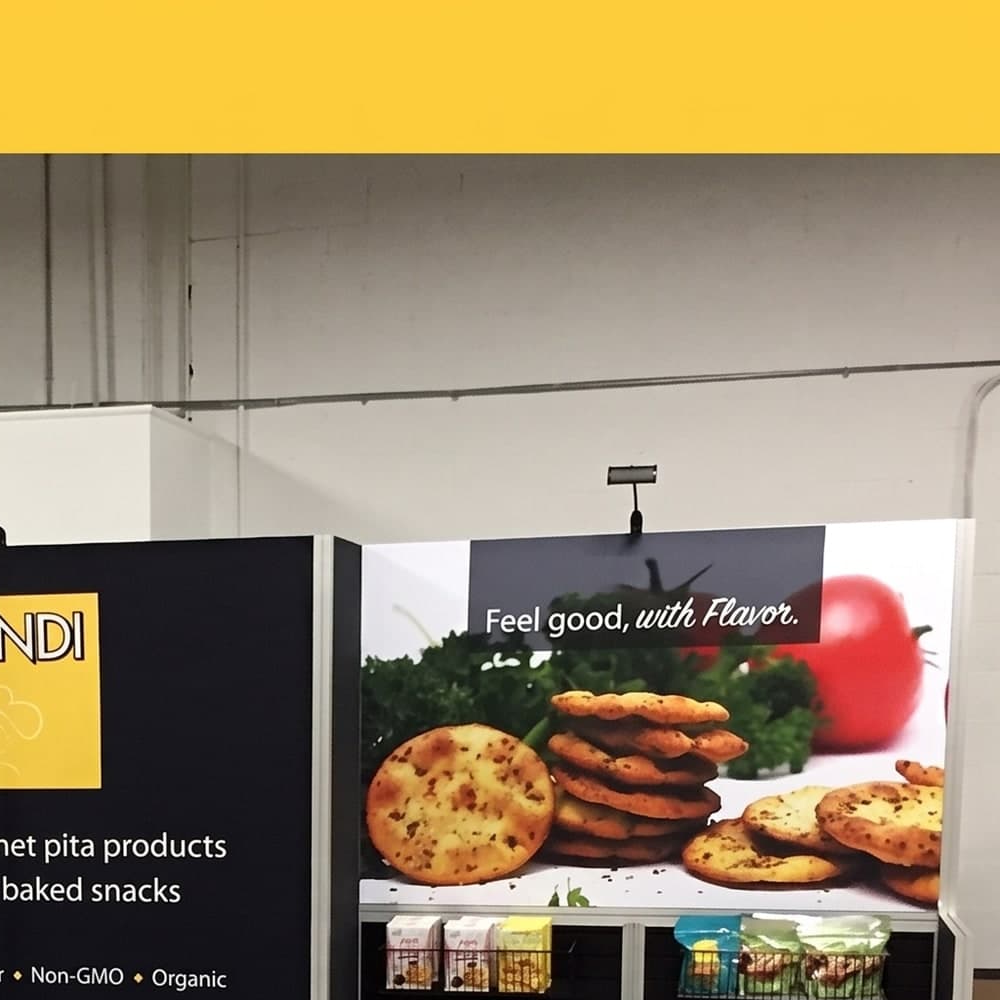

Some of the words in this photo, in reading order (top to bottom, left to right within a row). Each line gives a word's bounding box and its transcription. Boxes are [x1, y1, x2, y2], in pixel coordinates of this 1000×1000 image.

[486, 606, 540, 634] Feel
[549, 603, 629, 638] good,
[635, 597, 697, 629] with
[702, 597, 799, 627] Flavor.
[44, 832, 95, 863] pita
[104, 831, 227, 863] products
[2, 875, 83, 902] baked
[91, 877, 181, 903] snacks
[31, 966, 124, 986] Non-GMO
[151, 968, 227, 991] Organic
